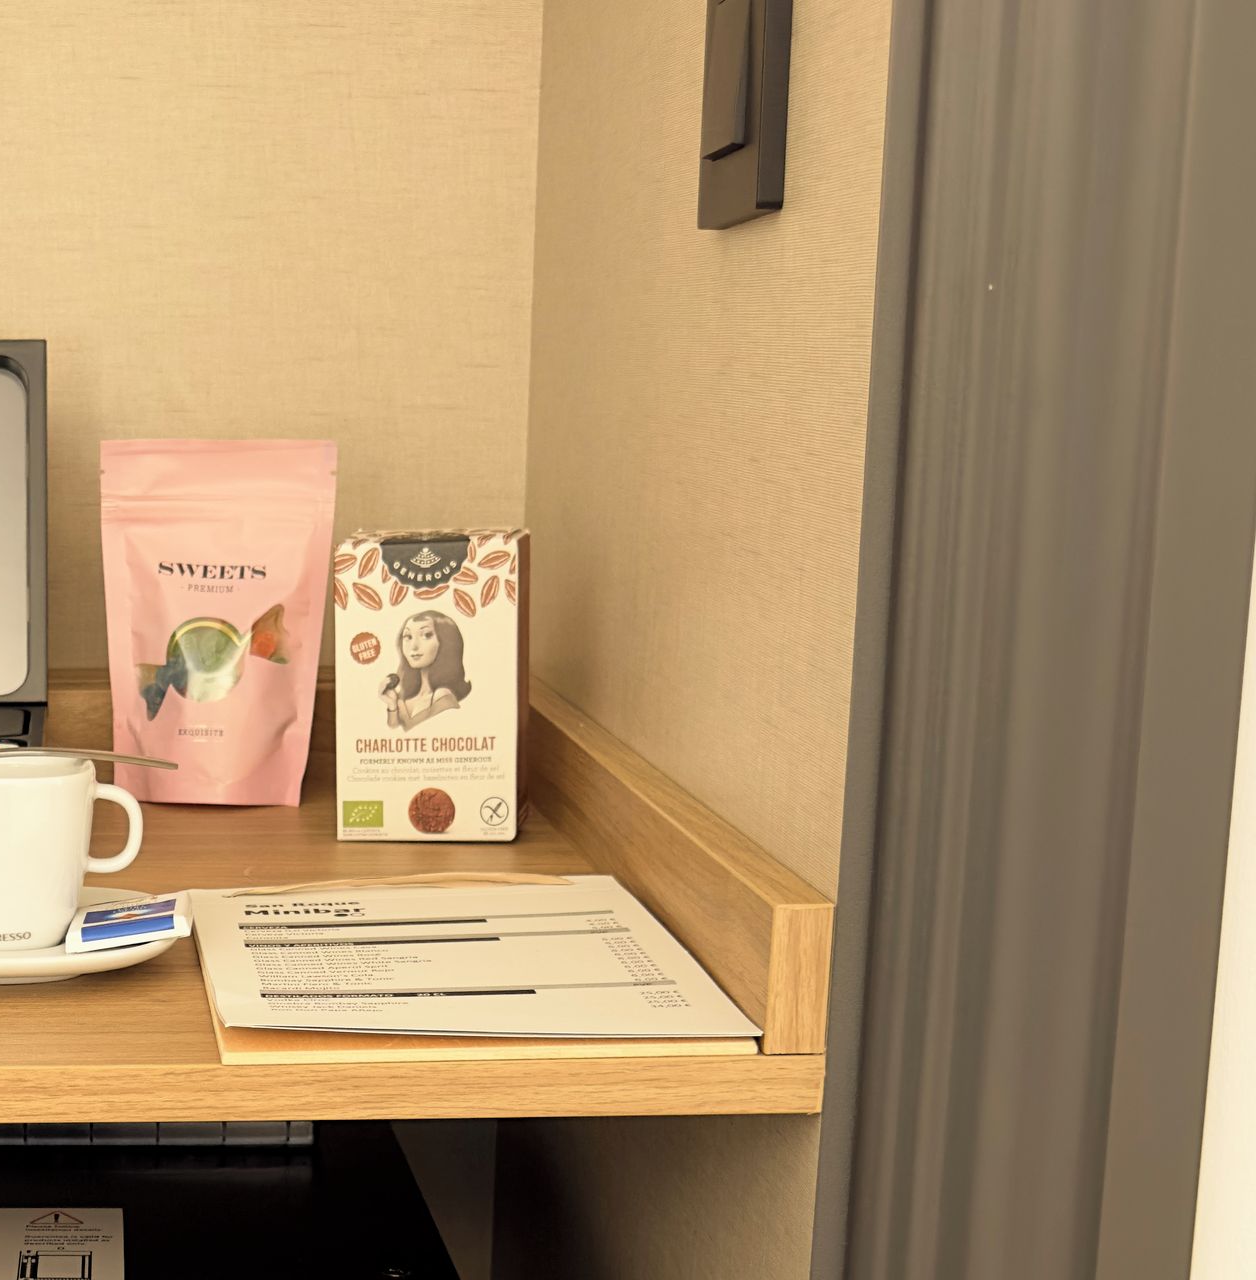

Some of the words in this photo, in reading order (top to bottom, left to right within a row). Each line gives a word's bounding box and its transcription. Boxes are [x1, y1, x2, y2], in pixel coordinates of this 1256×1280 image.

[157, 560, 267, 581] SWEETS
[393, 560, 458, 582] GENEROUS
[187, 584, 234, 594] PREMIUM
[351, 638, 378, 654] GLUTEN
[357, 648, 377, 662] FREE
[177, 727, 225, 738] EXQUISITE
[355, 737, 428, 754] CHARLOTTE
[431, 736, 497, 752] CHOCOLAT
[396, 757, 425, 765] KNOWN
[244, 908, 365, 916] Minibar
